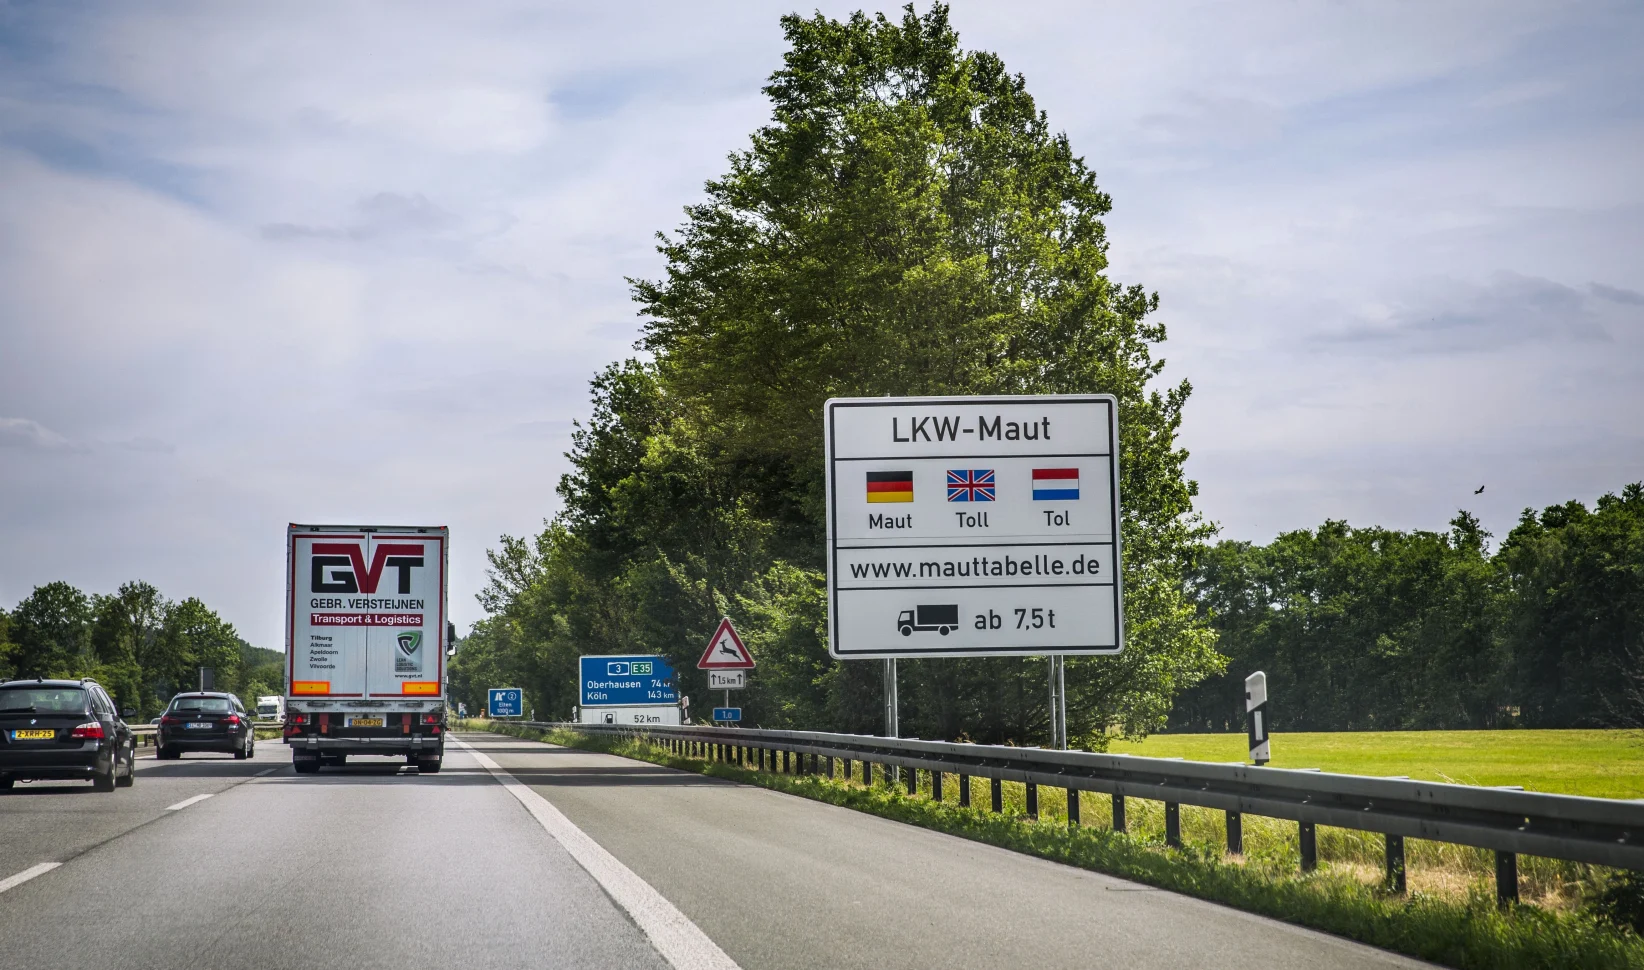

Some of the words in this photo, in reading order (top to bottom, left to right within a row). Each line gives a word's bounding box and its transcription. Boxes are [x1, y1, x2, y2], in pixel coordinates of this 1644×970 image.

[892, 415, 1051, 443] LKW-Maut
[868, 513, 913, 529] Maut
[955, 511, 989, 528] Toll
[1043, 510, 1070, 526] Tol
[311, 543, 425, 594] GVT
[850, 553, 1100, 578] www.mauttabelle.de
[310, 598, 346, 609] GEBR.
[348, 598, 424, 610] VERSTEIJNEN
[313, 614, 362, 625] Transport
[364, 614, 371, 623] &
[375, 614, 421, 625] Logistics
[974, 609, 1002, 630] ab
[615, 664, 622, 673] 3
[587, 680, 641, 689] Oberhausen
[651, 679, 662, 688] 74
[727, 677, 736, 685] km
[587, 692, 608, 700] Köln
[647, 690, 662, 699] 143
[634, 714, 645, 723] 52
[646, 714, 661, 723] km
